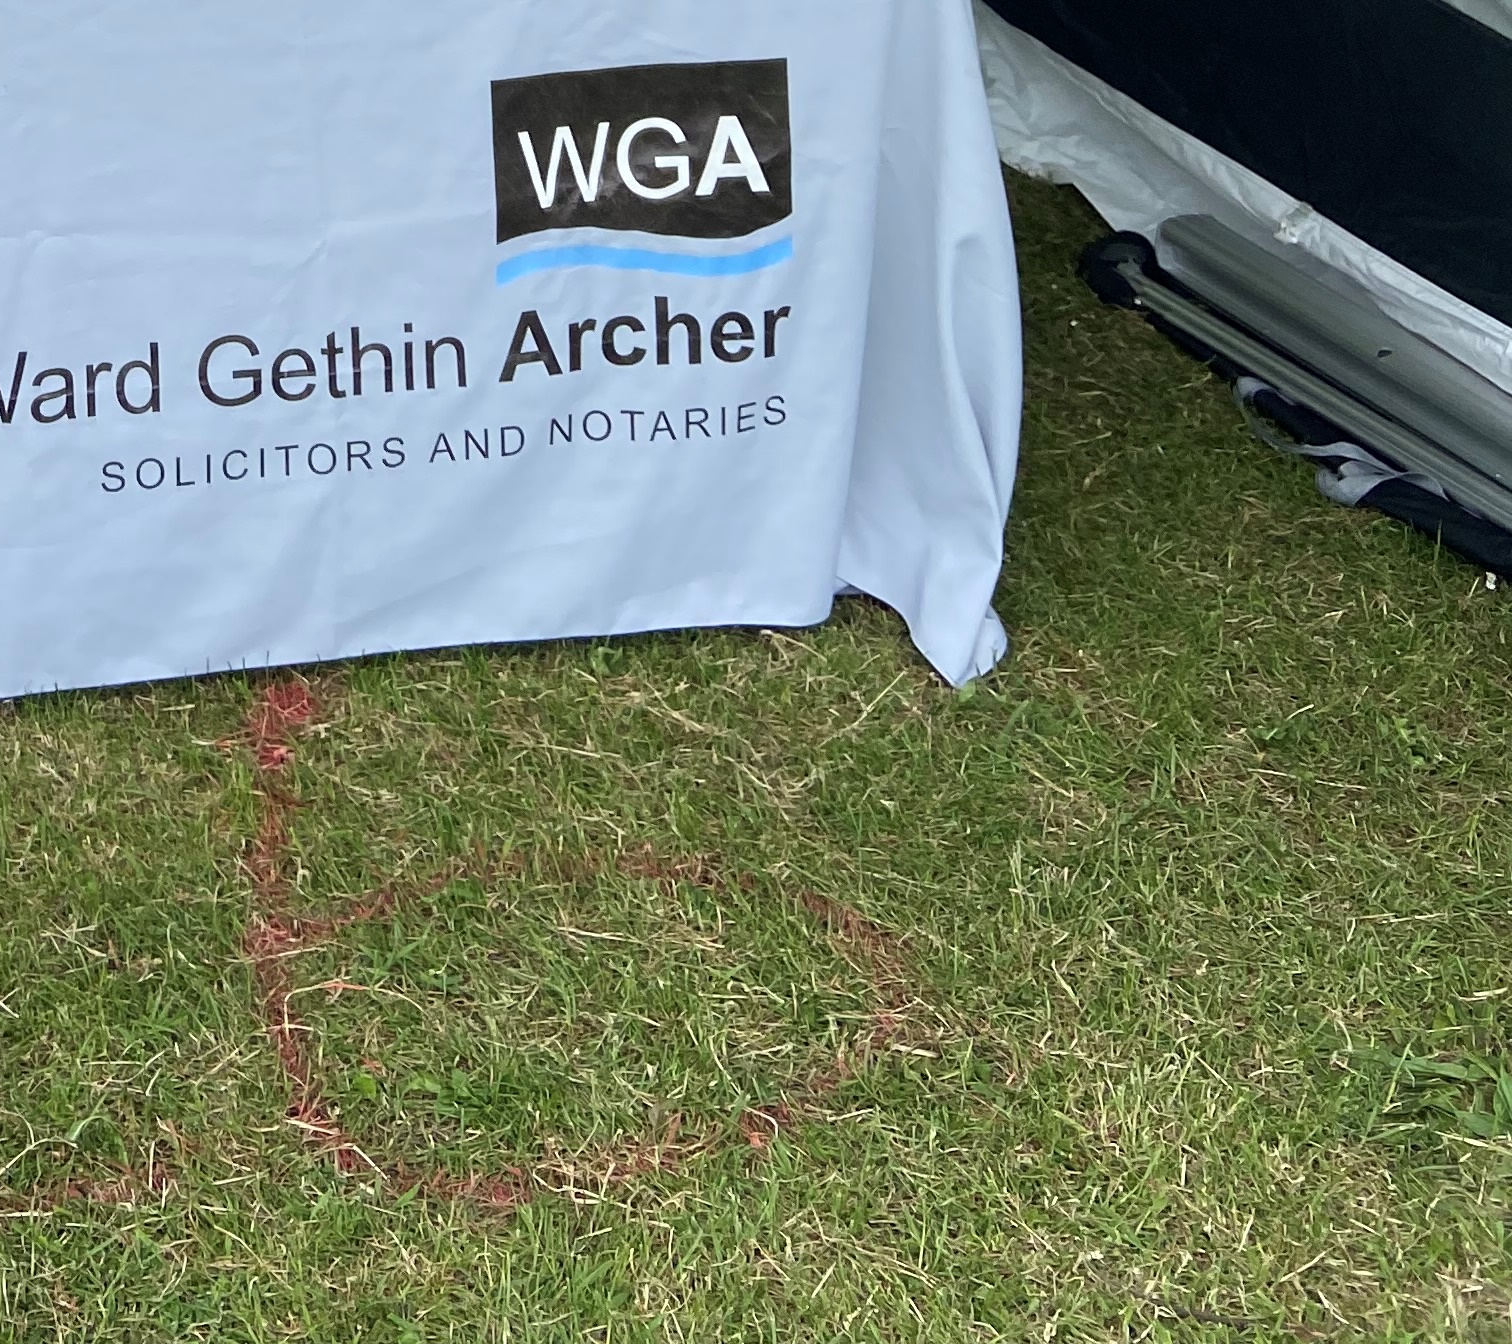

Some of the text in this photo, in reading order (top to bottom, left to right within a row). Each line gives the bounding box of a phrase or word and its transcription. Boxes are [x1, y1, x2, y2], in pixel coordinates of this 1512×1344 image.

[517, 114, 771, 210] WGA
[198, 322, 468, 407] Gethin
[498, 296, 792, 383] Archer
[100, 395, 787, 493] SOLICITORS AND NOTARIES
